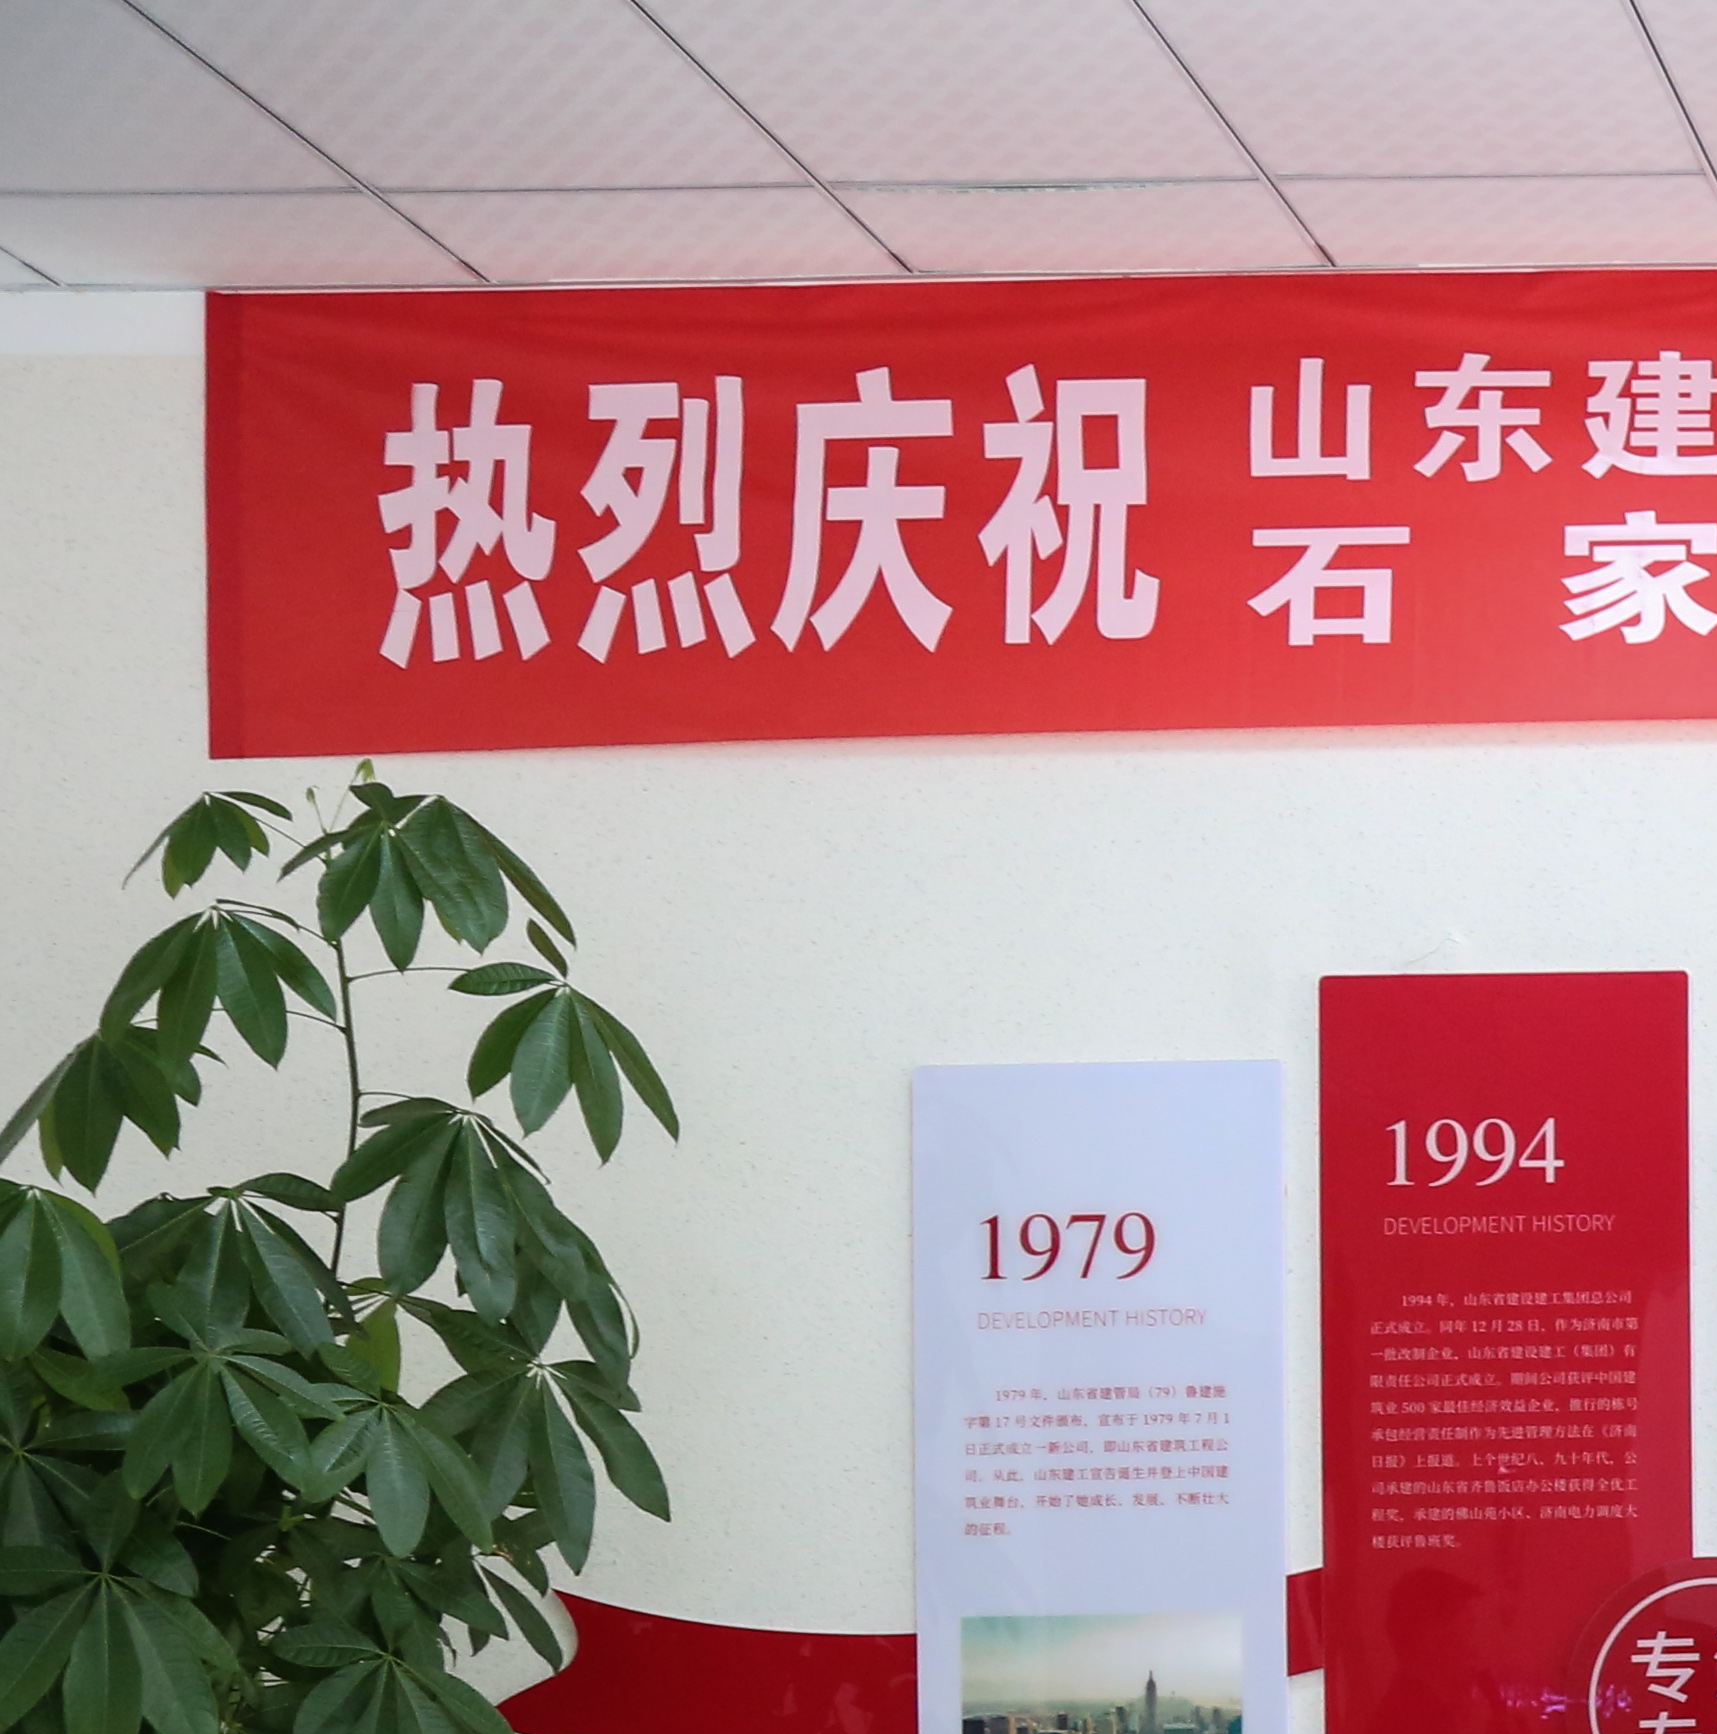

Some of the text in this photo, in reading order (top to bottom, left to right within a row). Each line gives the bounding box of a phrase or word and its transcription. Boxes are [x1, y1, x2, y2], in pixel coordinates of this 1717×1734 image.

[379, 362, 1160, 670] 热烈庆祝
[1385, 1118, 1565, 1187] 1994
[978, 1213, 1156, 1281] 1979
[1384, 1214, 1616, 1236] DEVELOPMENT HISTORY
[977, 1309, 1207, 1330] DEVELOPMENT HISTORY
